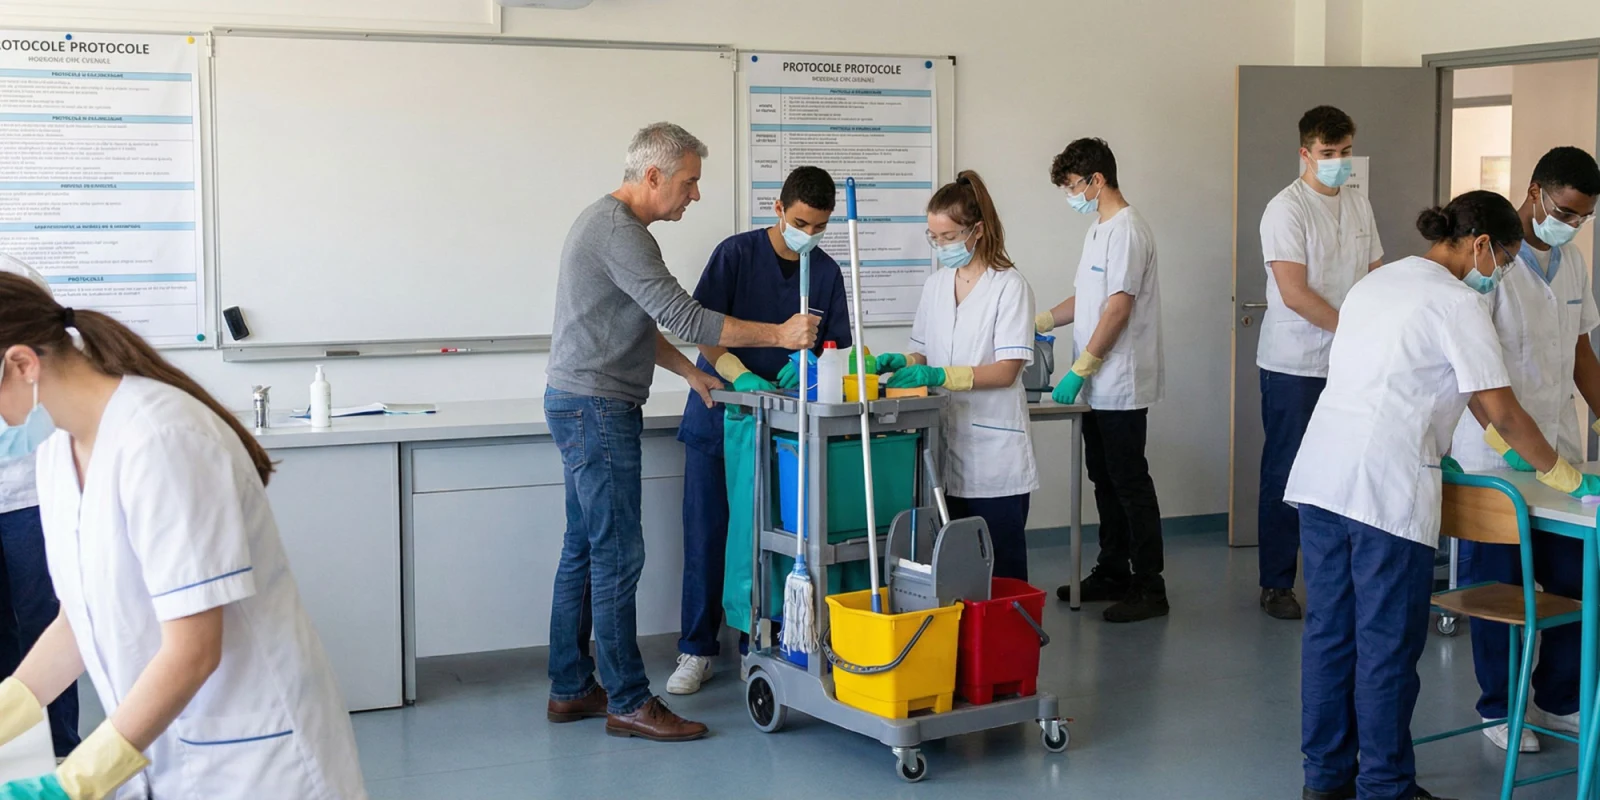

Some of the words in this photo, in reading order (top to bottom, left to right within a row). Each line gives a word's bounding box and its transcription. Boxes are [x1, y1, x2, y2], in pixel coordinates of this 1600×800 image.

[0, 39, 65, 52] OTOCOLE
[70, 41, 150, 54] PROTOCOLE
[783, 62, 842, 73] PROTOCOLE
[845, 63, 902, 75] PROTOCOLE
